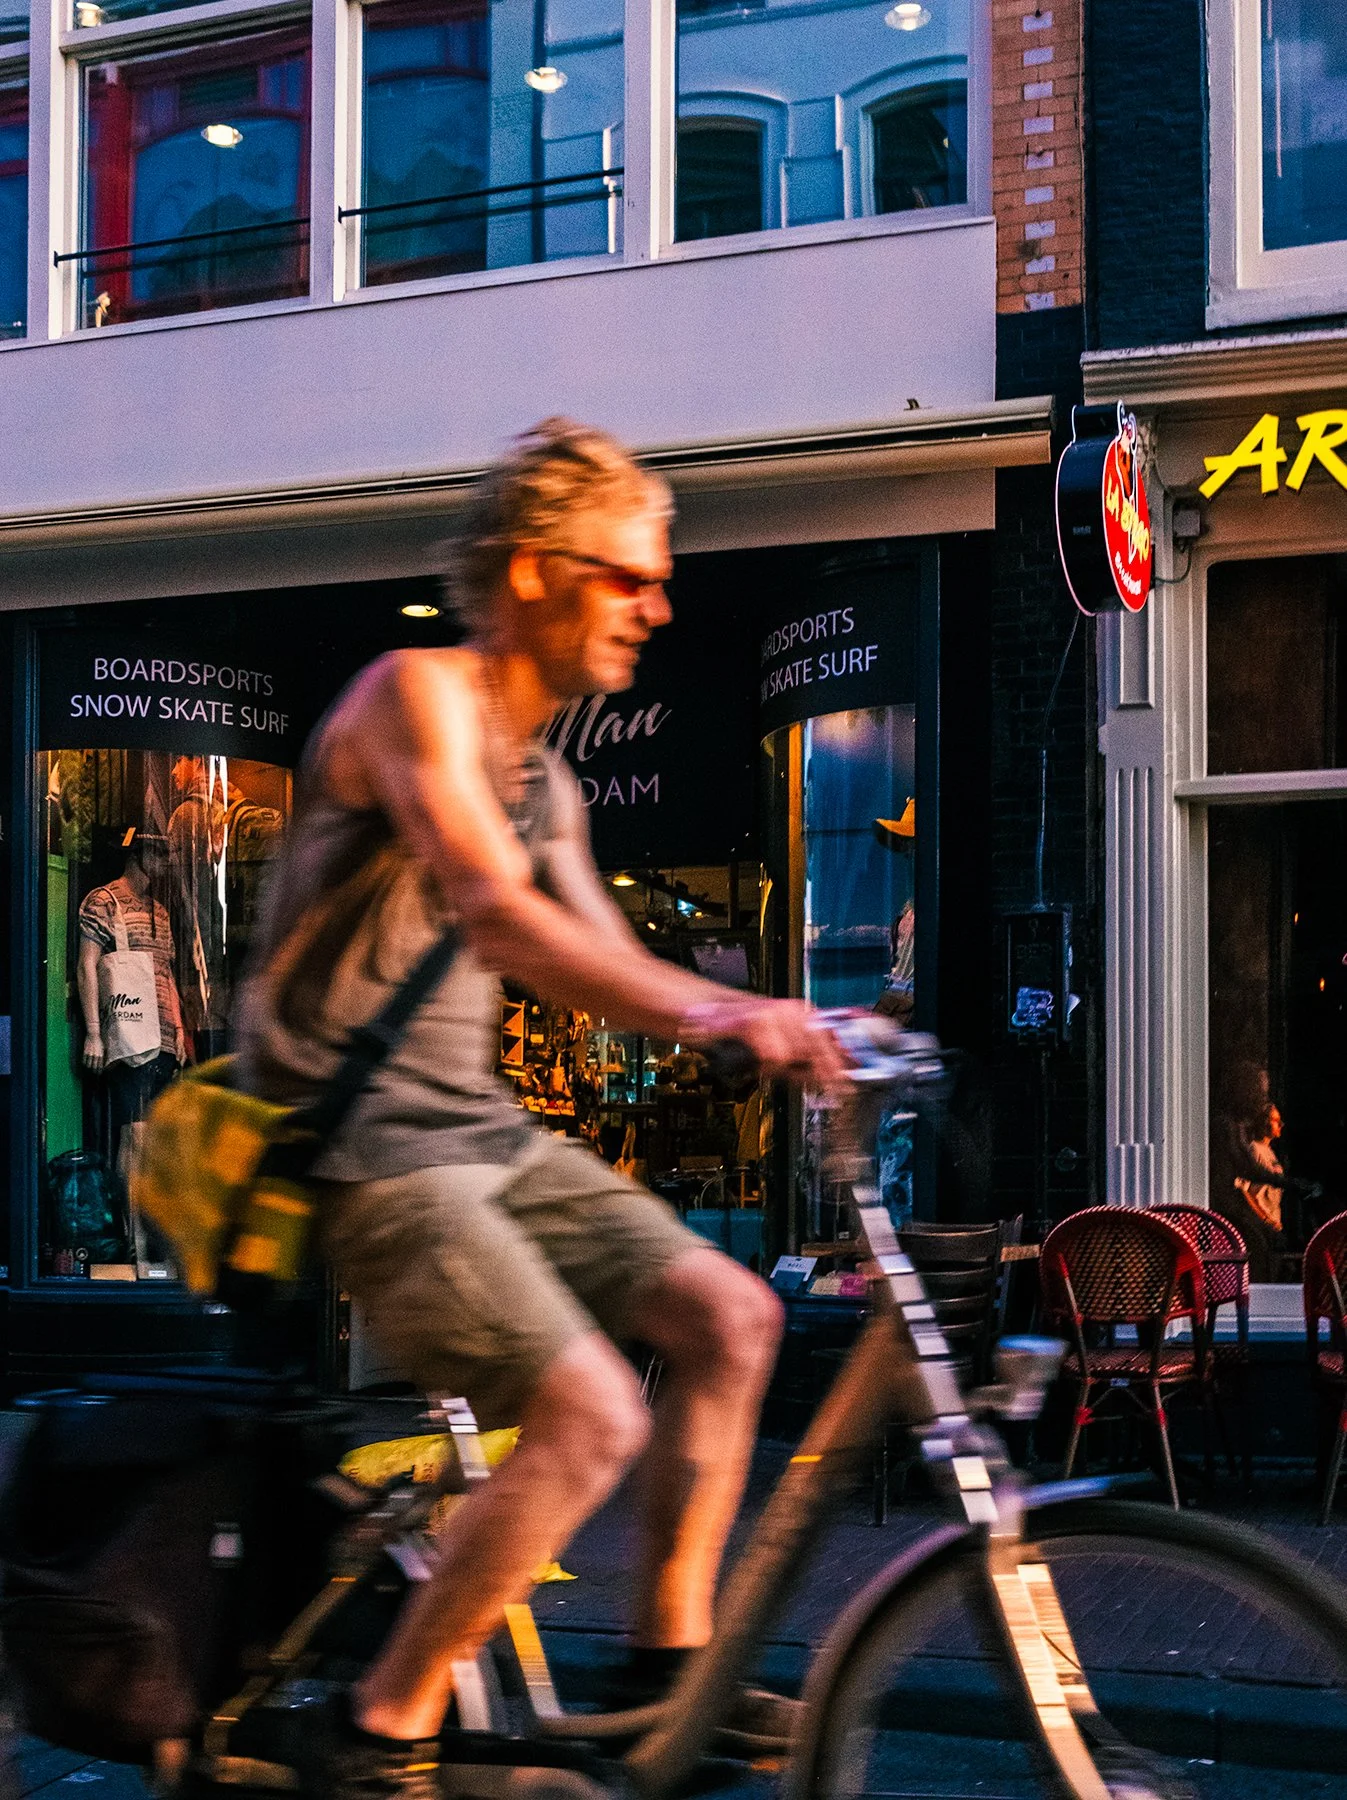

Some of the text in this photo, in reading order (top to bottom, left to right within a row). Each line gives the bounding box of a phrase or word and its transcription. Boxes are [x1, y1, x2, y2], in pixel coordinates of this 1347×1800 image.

[1199, 409, 1347, 499] AR
[762, 606, 855, 664] ARDSPORTS
[94, 657, 274, 696] BOARDSPORTS
[769, 657, 813, 697] SKATE
[818, 644, 879, 681] SURF
[70, 694, 289, 735] SNOW SKATE SURF
[542, 691, 673, 762] Man
[578, 773, 660, 807] DAM
[110, 993, 142, 1010] Man
[112, 1011, 144, 1019] ERDAM
